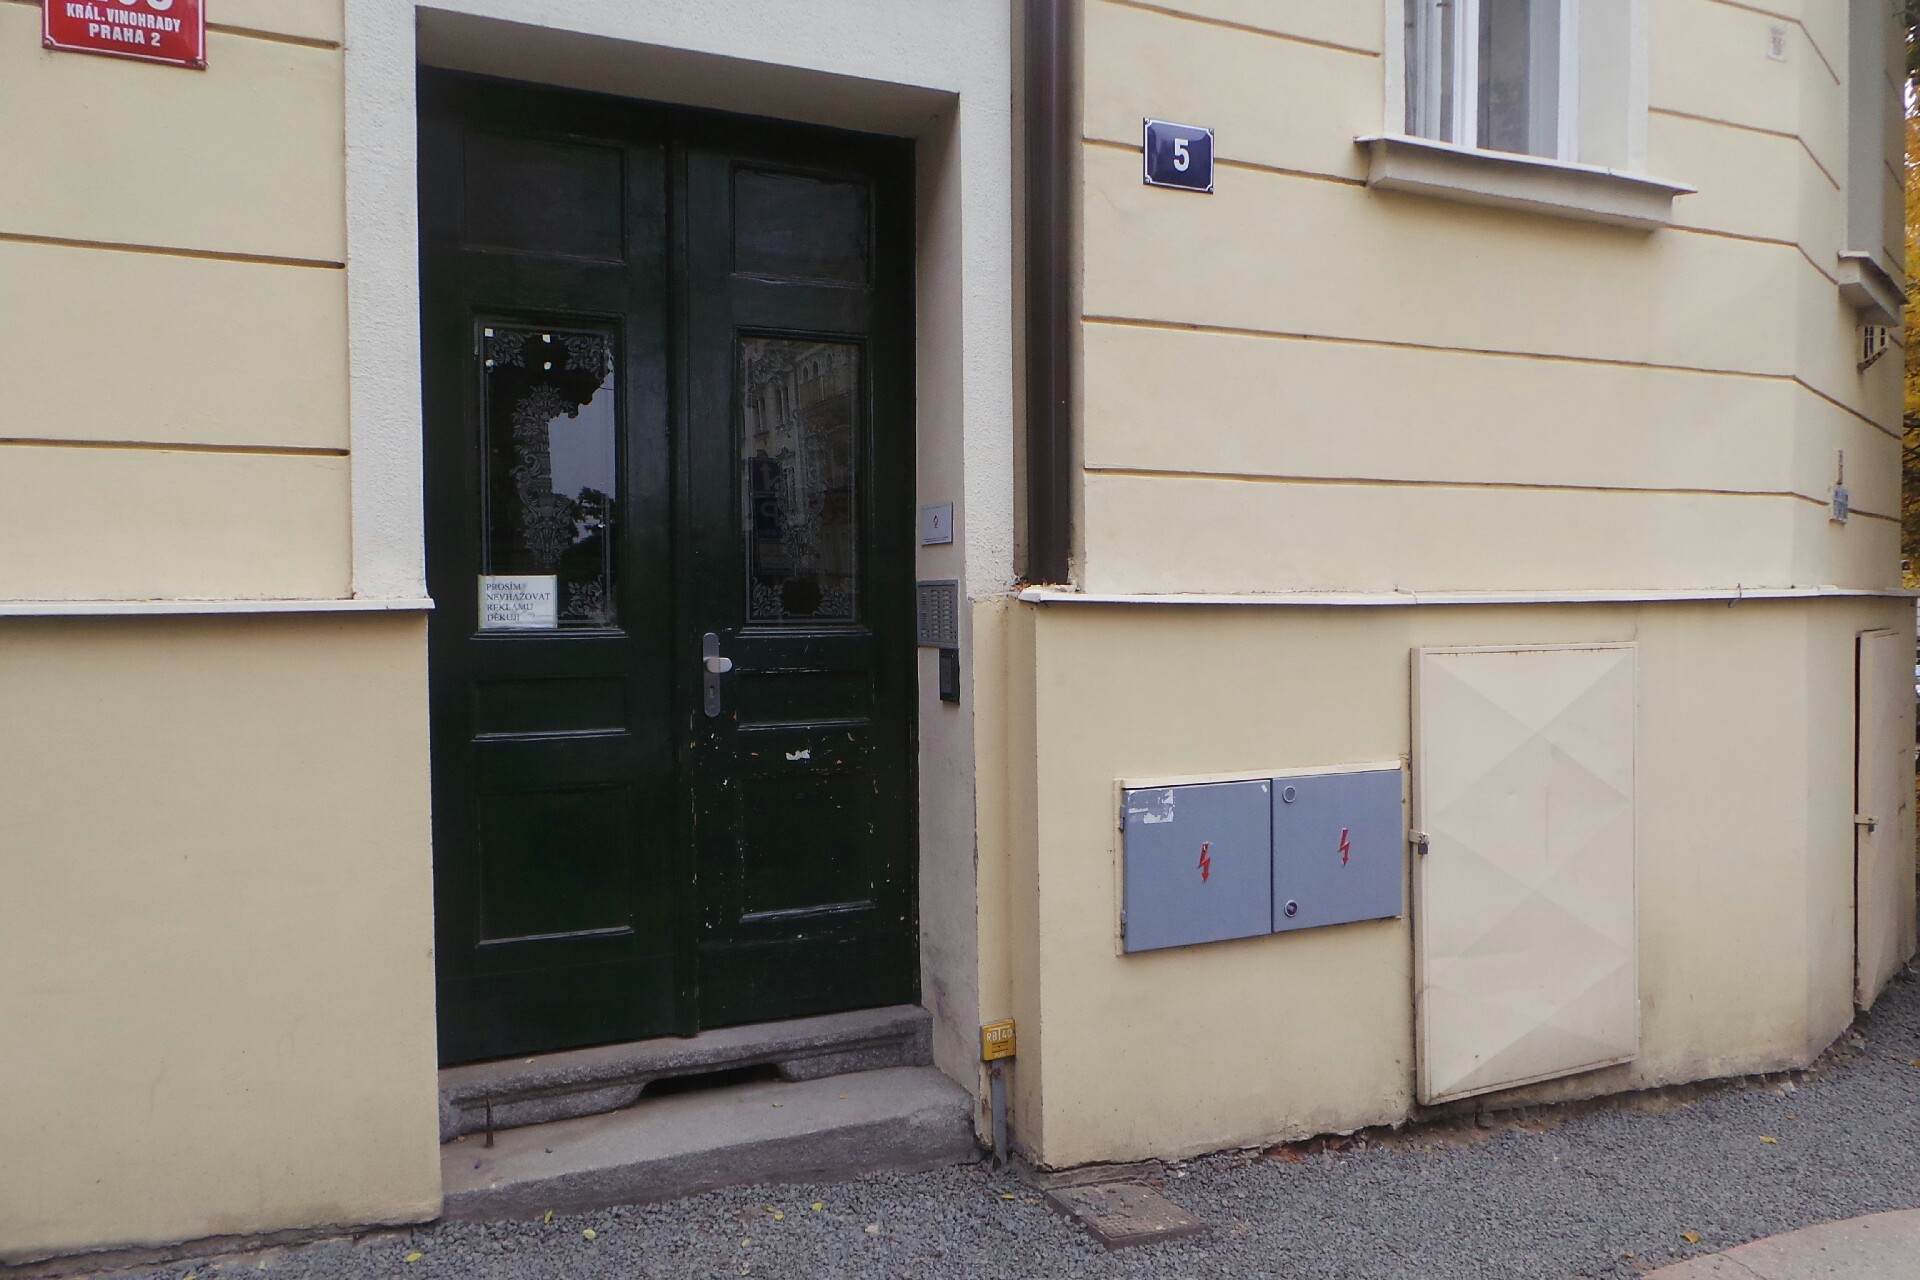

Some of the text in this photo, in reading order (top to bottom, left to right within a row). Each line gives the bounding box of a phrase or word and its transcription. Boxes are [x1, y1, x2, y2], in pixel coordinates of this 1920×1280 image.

[66, 2, 105, 21] KRÁL.
[106, 8, 181, 32] VINOHRADY
[89, 22, 161, 47] PRAHA 2
[1173, 137, 1190, 172] 5
[486, 581, 521, 591] PROSÍM
[486, 592, 551, 601] NEVHAZOVAT
[487, 603, 534, 611] REKLAMU
[487, 613, 520, 621] DĚKUJI
[1002, 1028, 1013, 1038] 40
